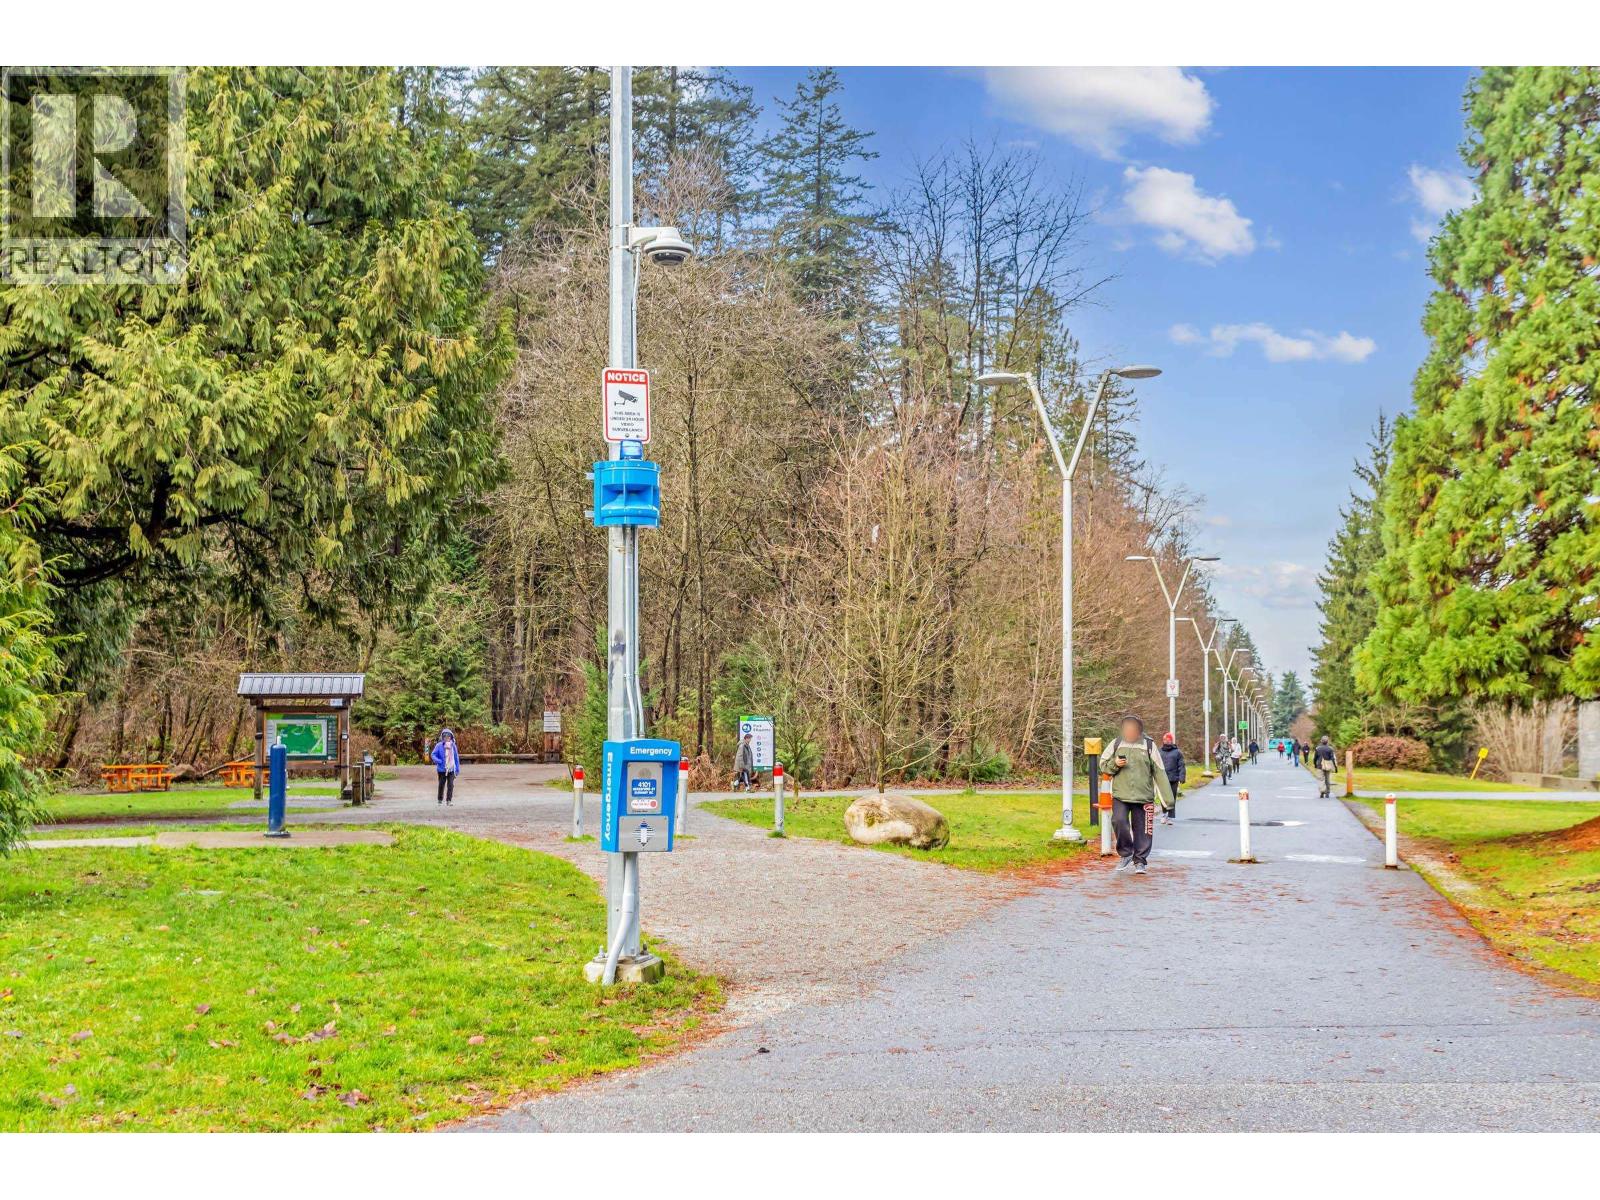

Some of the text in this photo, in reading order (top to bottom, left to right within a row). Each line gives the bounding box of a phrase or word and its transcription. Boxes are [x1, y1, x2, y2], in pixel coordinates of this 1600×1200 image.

[607, 372, 645, 382] NOTICE
[630, 746, 672, 756] Emergency
[605, 752, 613, 841] Emergency
